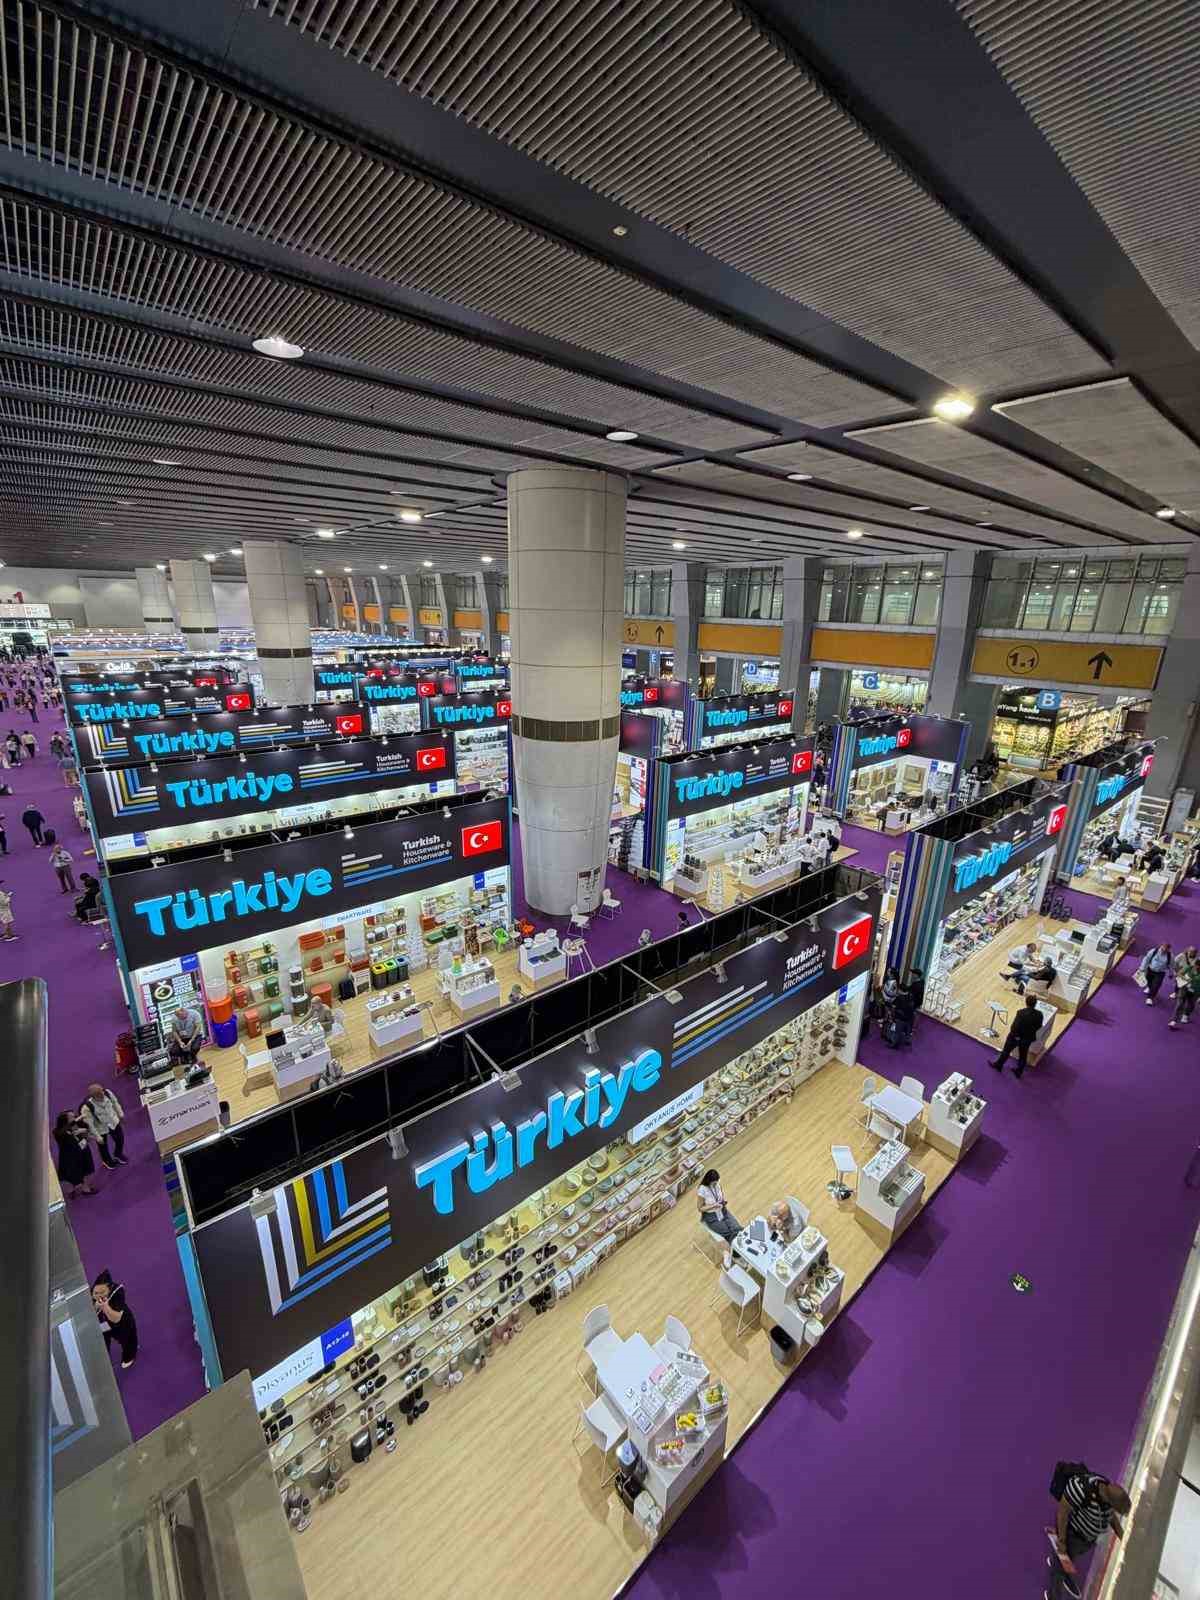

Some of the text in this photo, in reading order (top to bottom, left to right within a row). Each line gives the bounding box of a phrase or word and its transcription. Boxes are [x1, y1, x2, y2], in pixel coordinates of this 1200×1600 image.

[748, 663, 756, 673] D
[1009, 652, 1035, 668] 1.1
[456, 665, 494, 677] Türkiye
[865, 676, 875, 688] C
[364, 685, 416, 699] Türkiye
[1042, 692, 1055, 707] B
[74, 701, 160, 721] Türkiye
[433, 704, 495, 722] Türkiye
[706, 708, 748, 727] Türkiye
[134, 729, 235, 755] Türkiye
[376, 753, 402, 762] Turkish
[166, 771, 294, 808] Türkiye
[674, 770, 743, 803] Türkiye
[402, 834, 440, 850] Turkish
[403, 843, 445, 858] Houseware
[403, 849, 449, 865] Kitchenware
[134, 866, 333, 936] Türkiye
[786, 944, 819, 969] Turkish
[784, 953, 821, 981] Houseware
[782, 962, 823, 992] Kitchenware
[644, 1104, 676, 1131] OKYANUS
[415, 1048, 662, 1215] Türkiye
